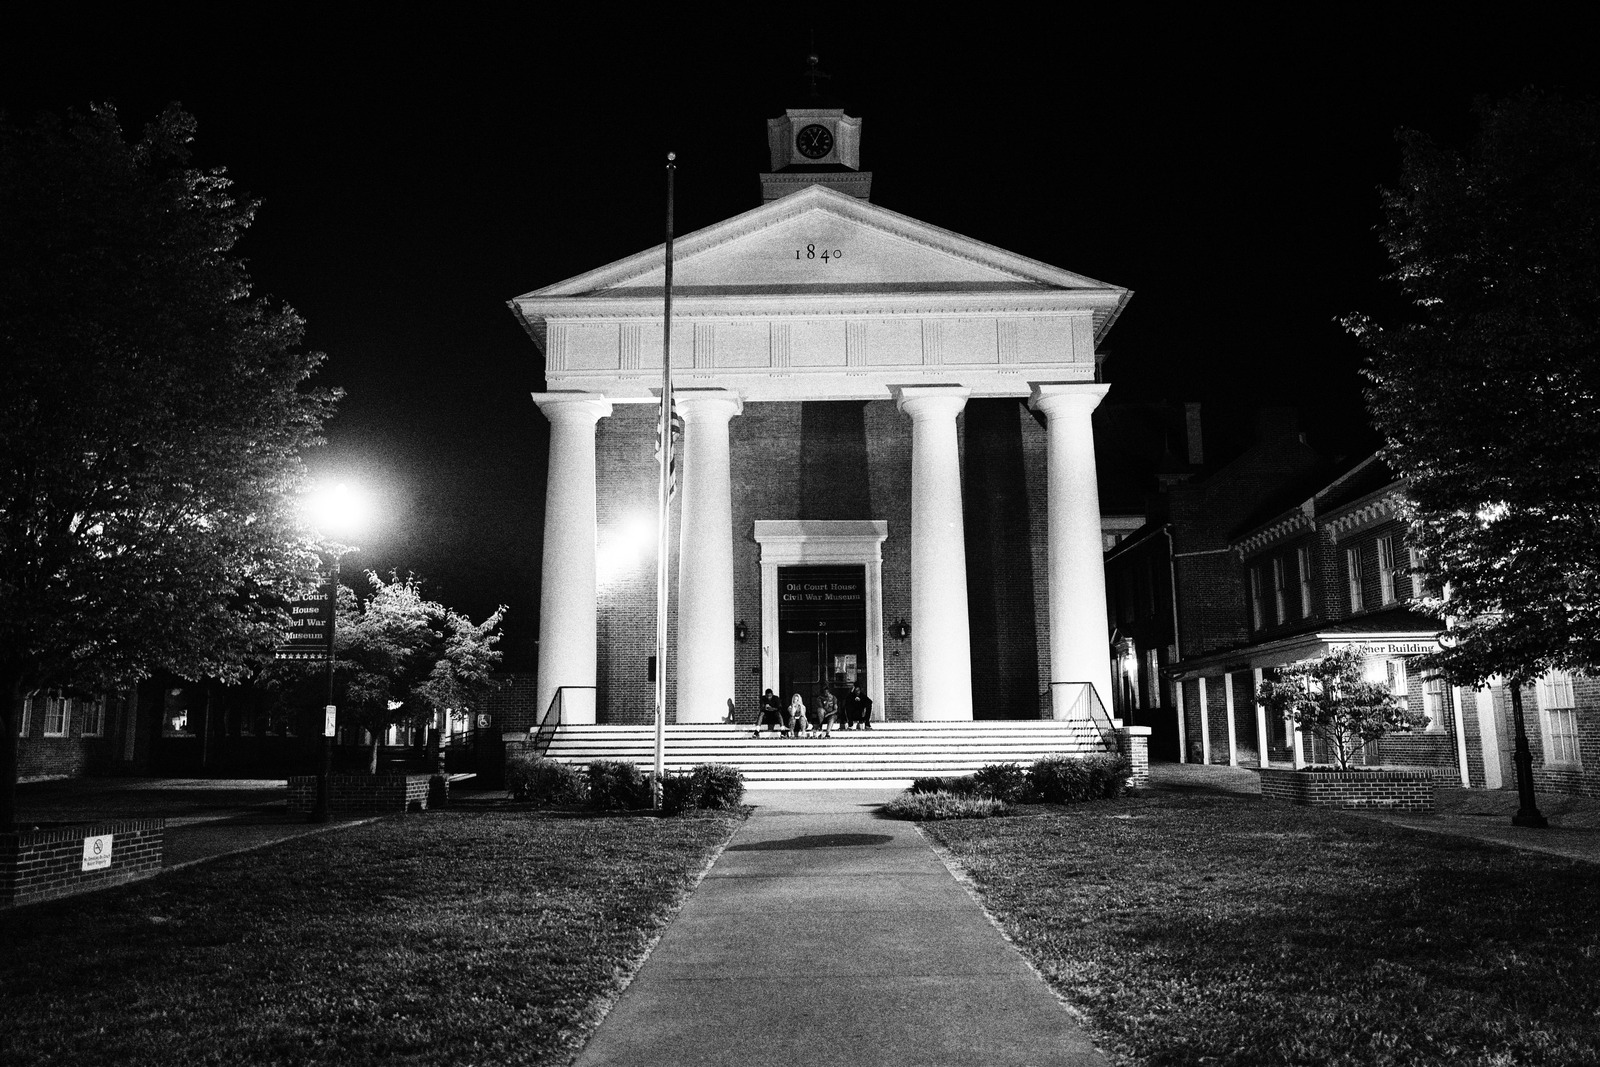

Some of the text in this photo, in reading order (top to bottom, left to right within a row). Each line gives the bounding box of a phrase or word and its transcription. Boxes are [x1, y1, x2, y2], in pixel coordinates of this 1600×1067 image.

[796, 243, 842, 264] 1840
[786, 583, 857, 591] Old Court House
[302, 593, 329, 601] Court
[783, 593, 861, 601] Civil War Museum
[292, 606, 320, 614] House
[288, 618, 327, 627] ivil War
[285, 632, 323, 640] Museum
[1387, 643, 1435, 654] Building
